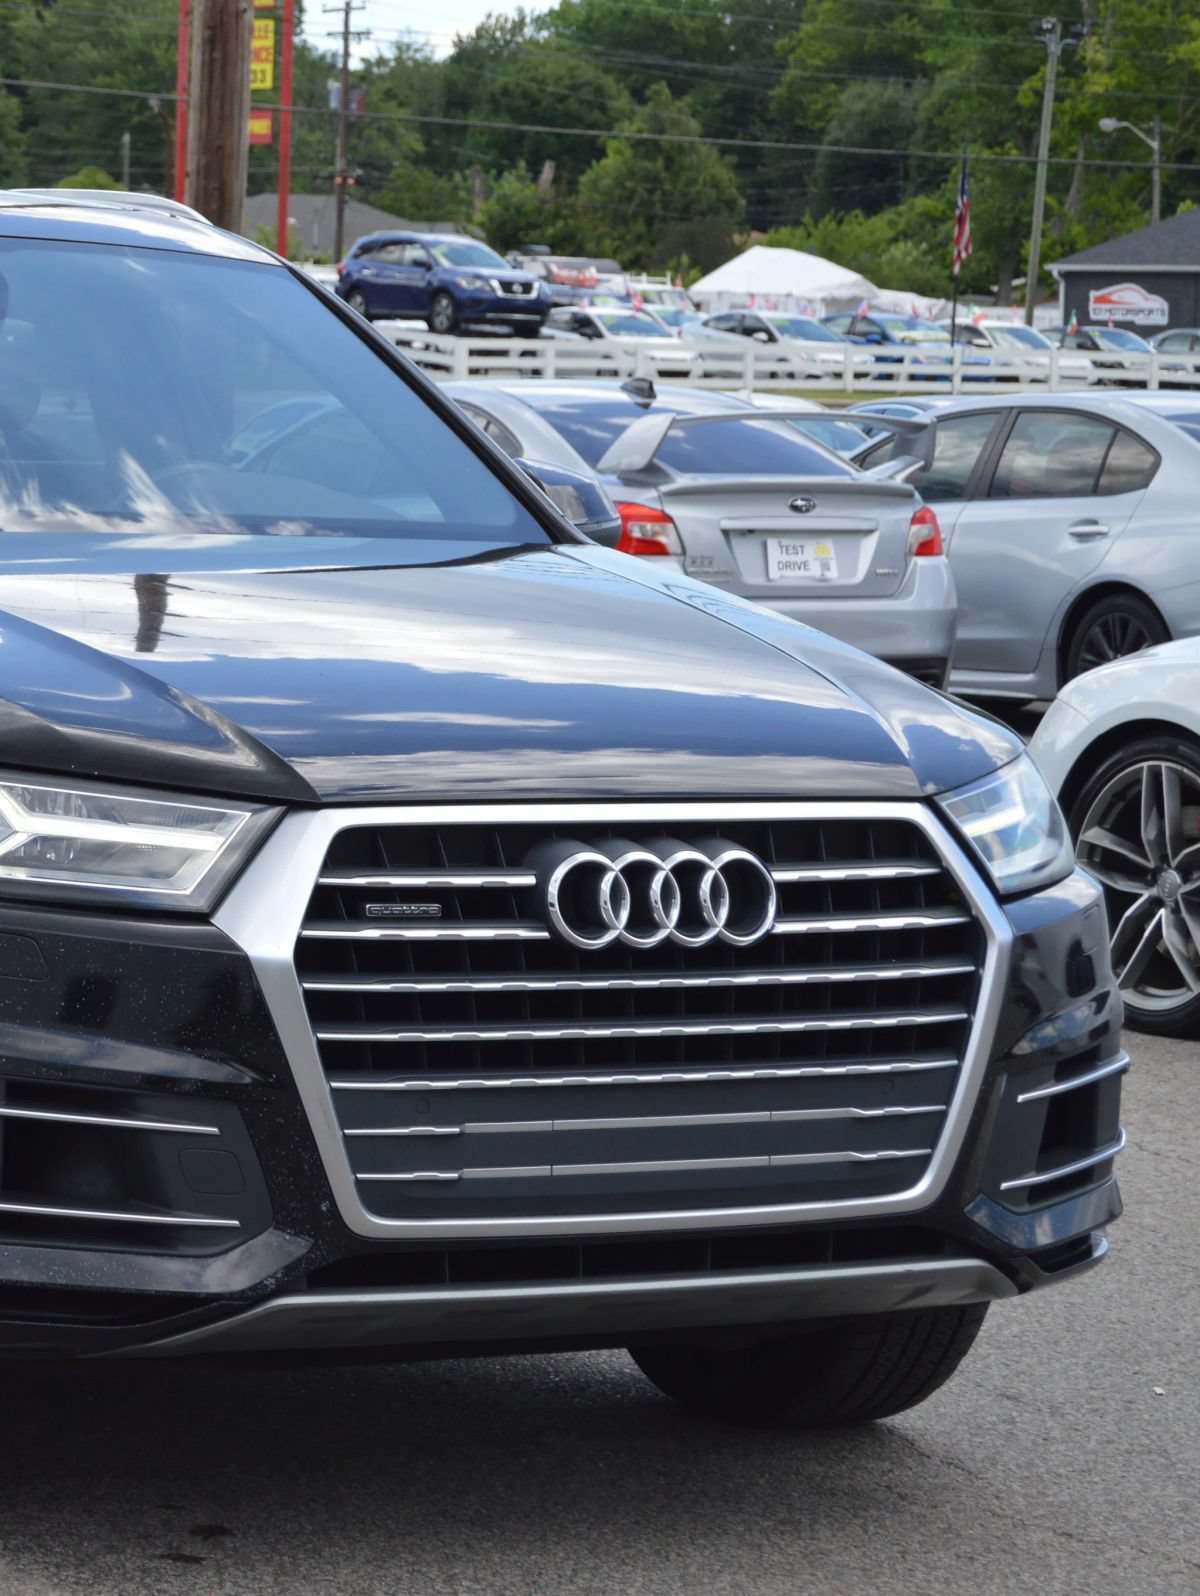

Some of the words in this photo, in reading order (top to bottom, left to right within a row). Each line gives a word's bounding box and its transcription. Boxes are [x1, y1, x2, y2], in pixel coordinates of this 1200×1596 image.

[779, 543, 806, 556] TEST
[777, 560, 811, 572] DRIVE
[369, 905, 440, 916] quattro
